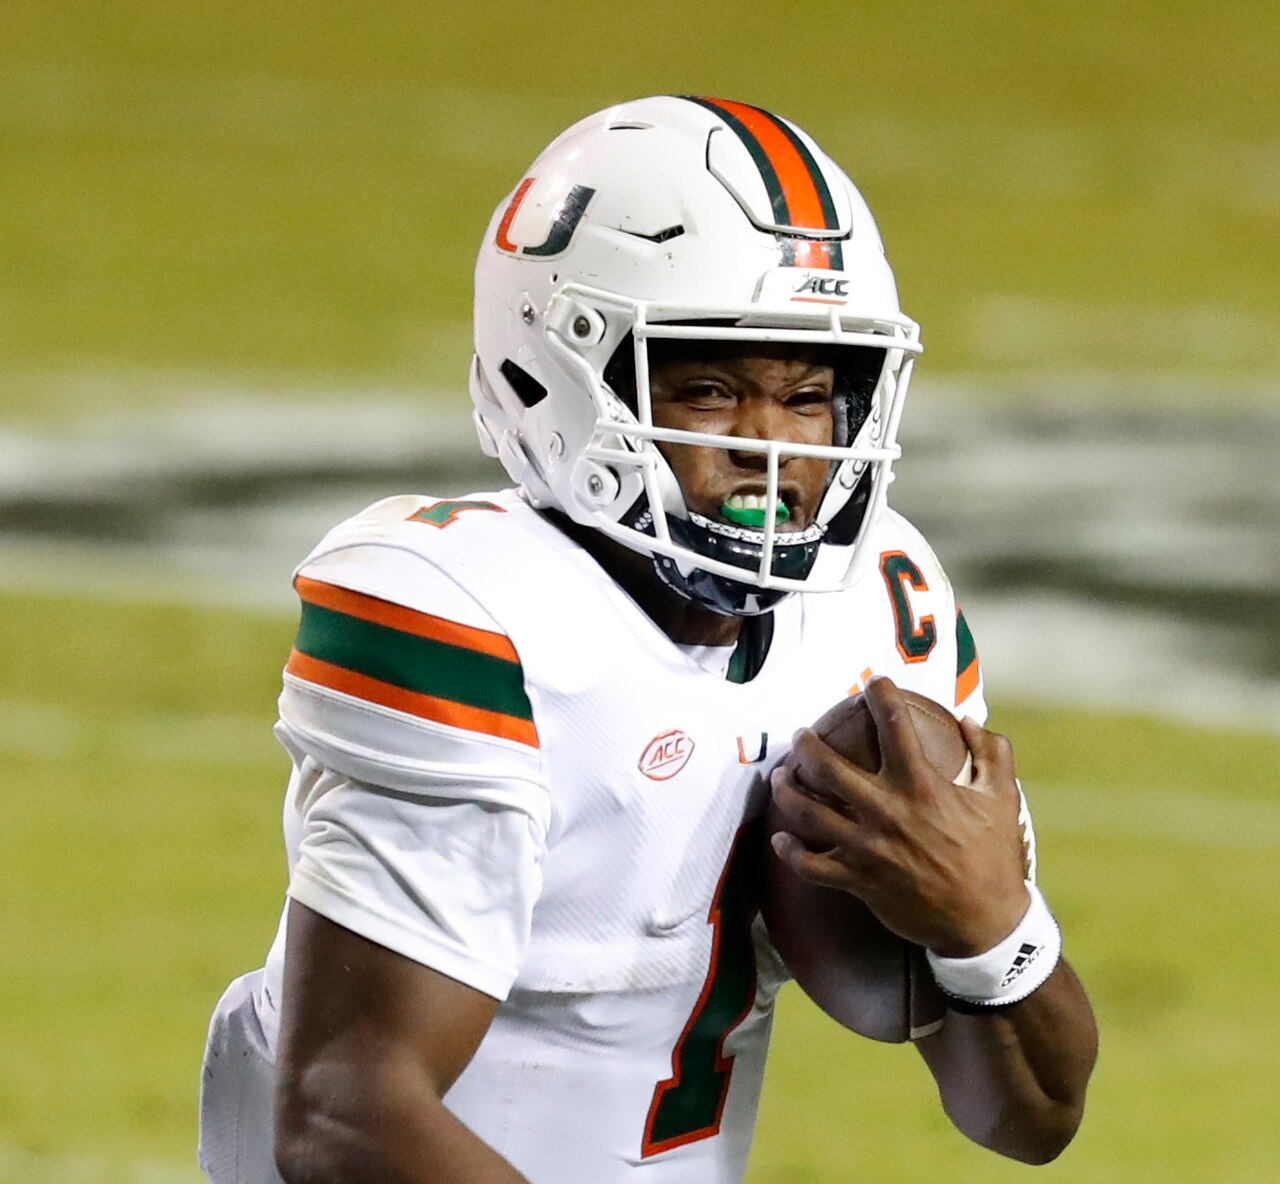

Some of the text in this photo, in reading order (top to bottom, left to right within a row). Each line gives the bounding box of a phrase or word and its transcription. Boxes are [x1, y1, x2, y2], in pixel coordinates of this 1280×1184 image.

[794, 276, 851, 296] ACC
[878, 549, 937, 664] C
[649, 736, 685, 766] ACC
[641, 815, 770, 1160] 1
